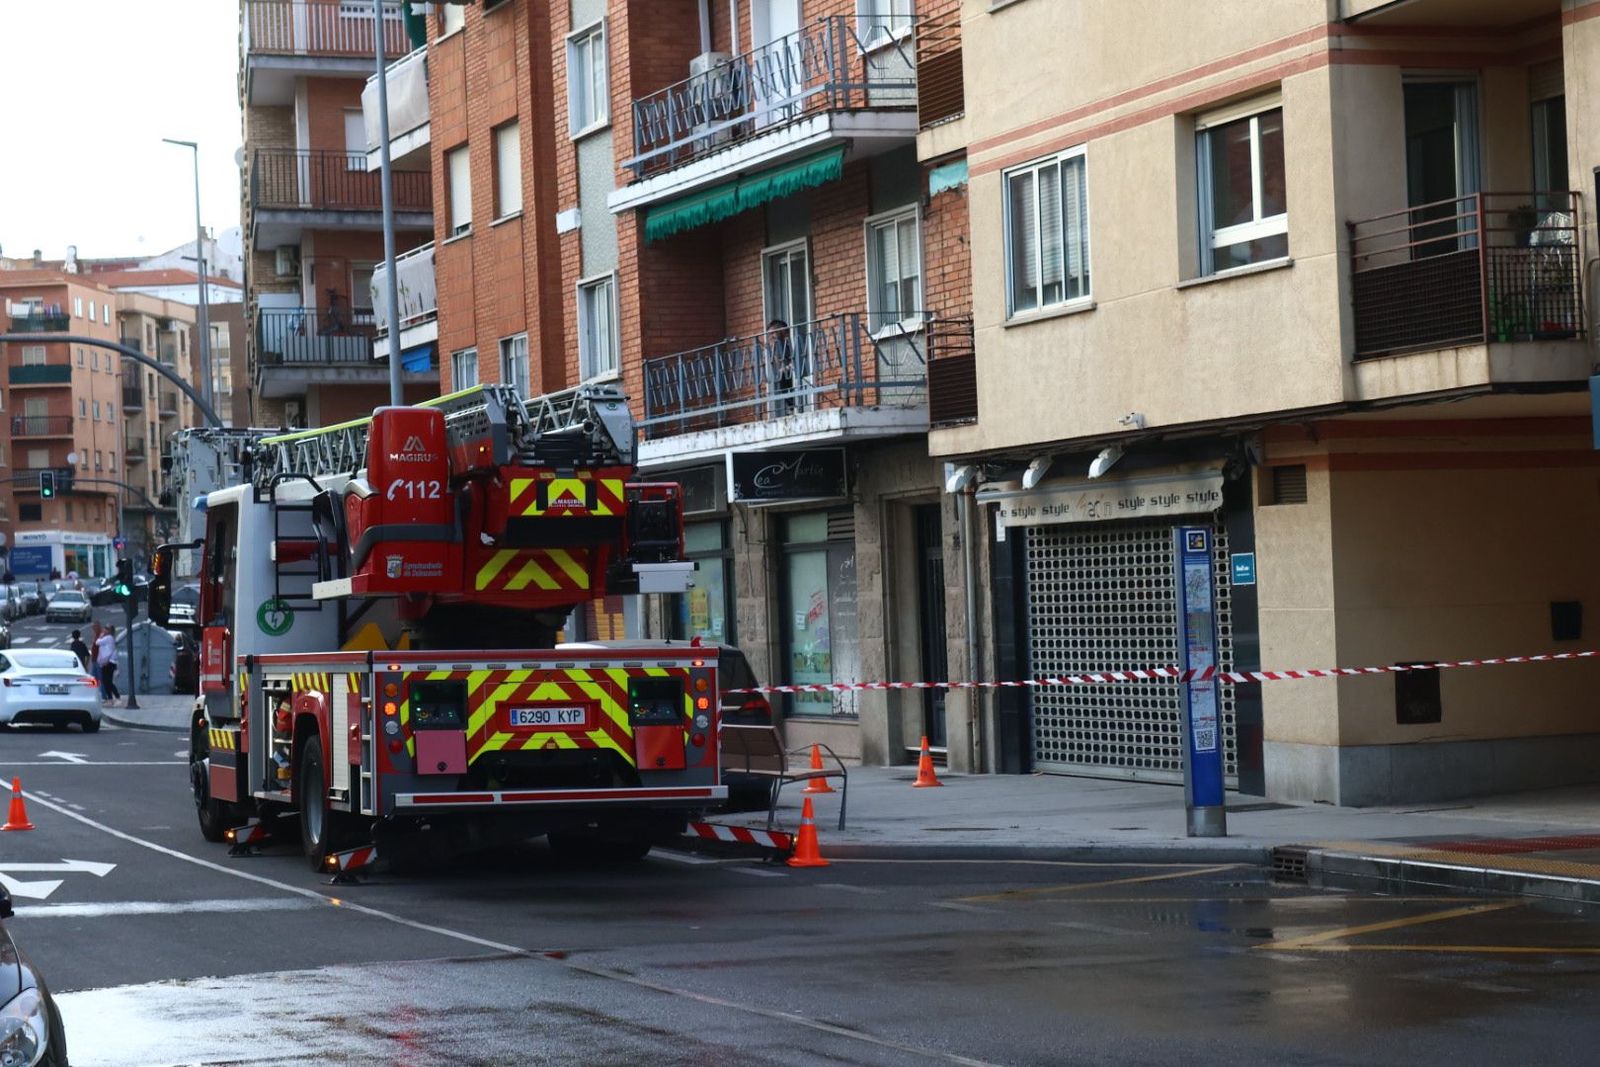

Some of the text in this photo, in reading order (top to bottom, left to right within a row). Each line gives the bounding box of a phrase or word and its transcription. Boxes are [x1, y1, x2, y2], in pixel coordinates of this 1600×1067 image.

[405, 480, 440, 499] 112
[1011, 505, 1037, 519] style
[1042, 503, 1070, 517] style
[1117, 496, 1145, 511] style
[1150, 493, 1181, 507] style
[1186, 489, 1219, 504] style
[519, 709, 581, 724] 6290 KYP
